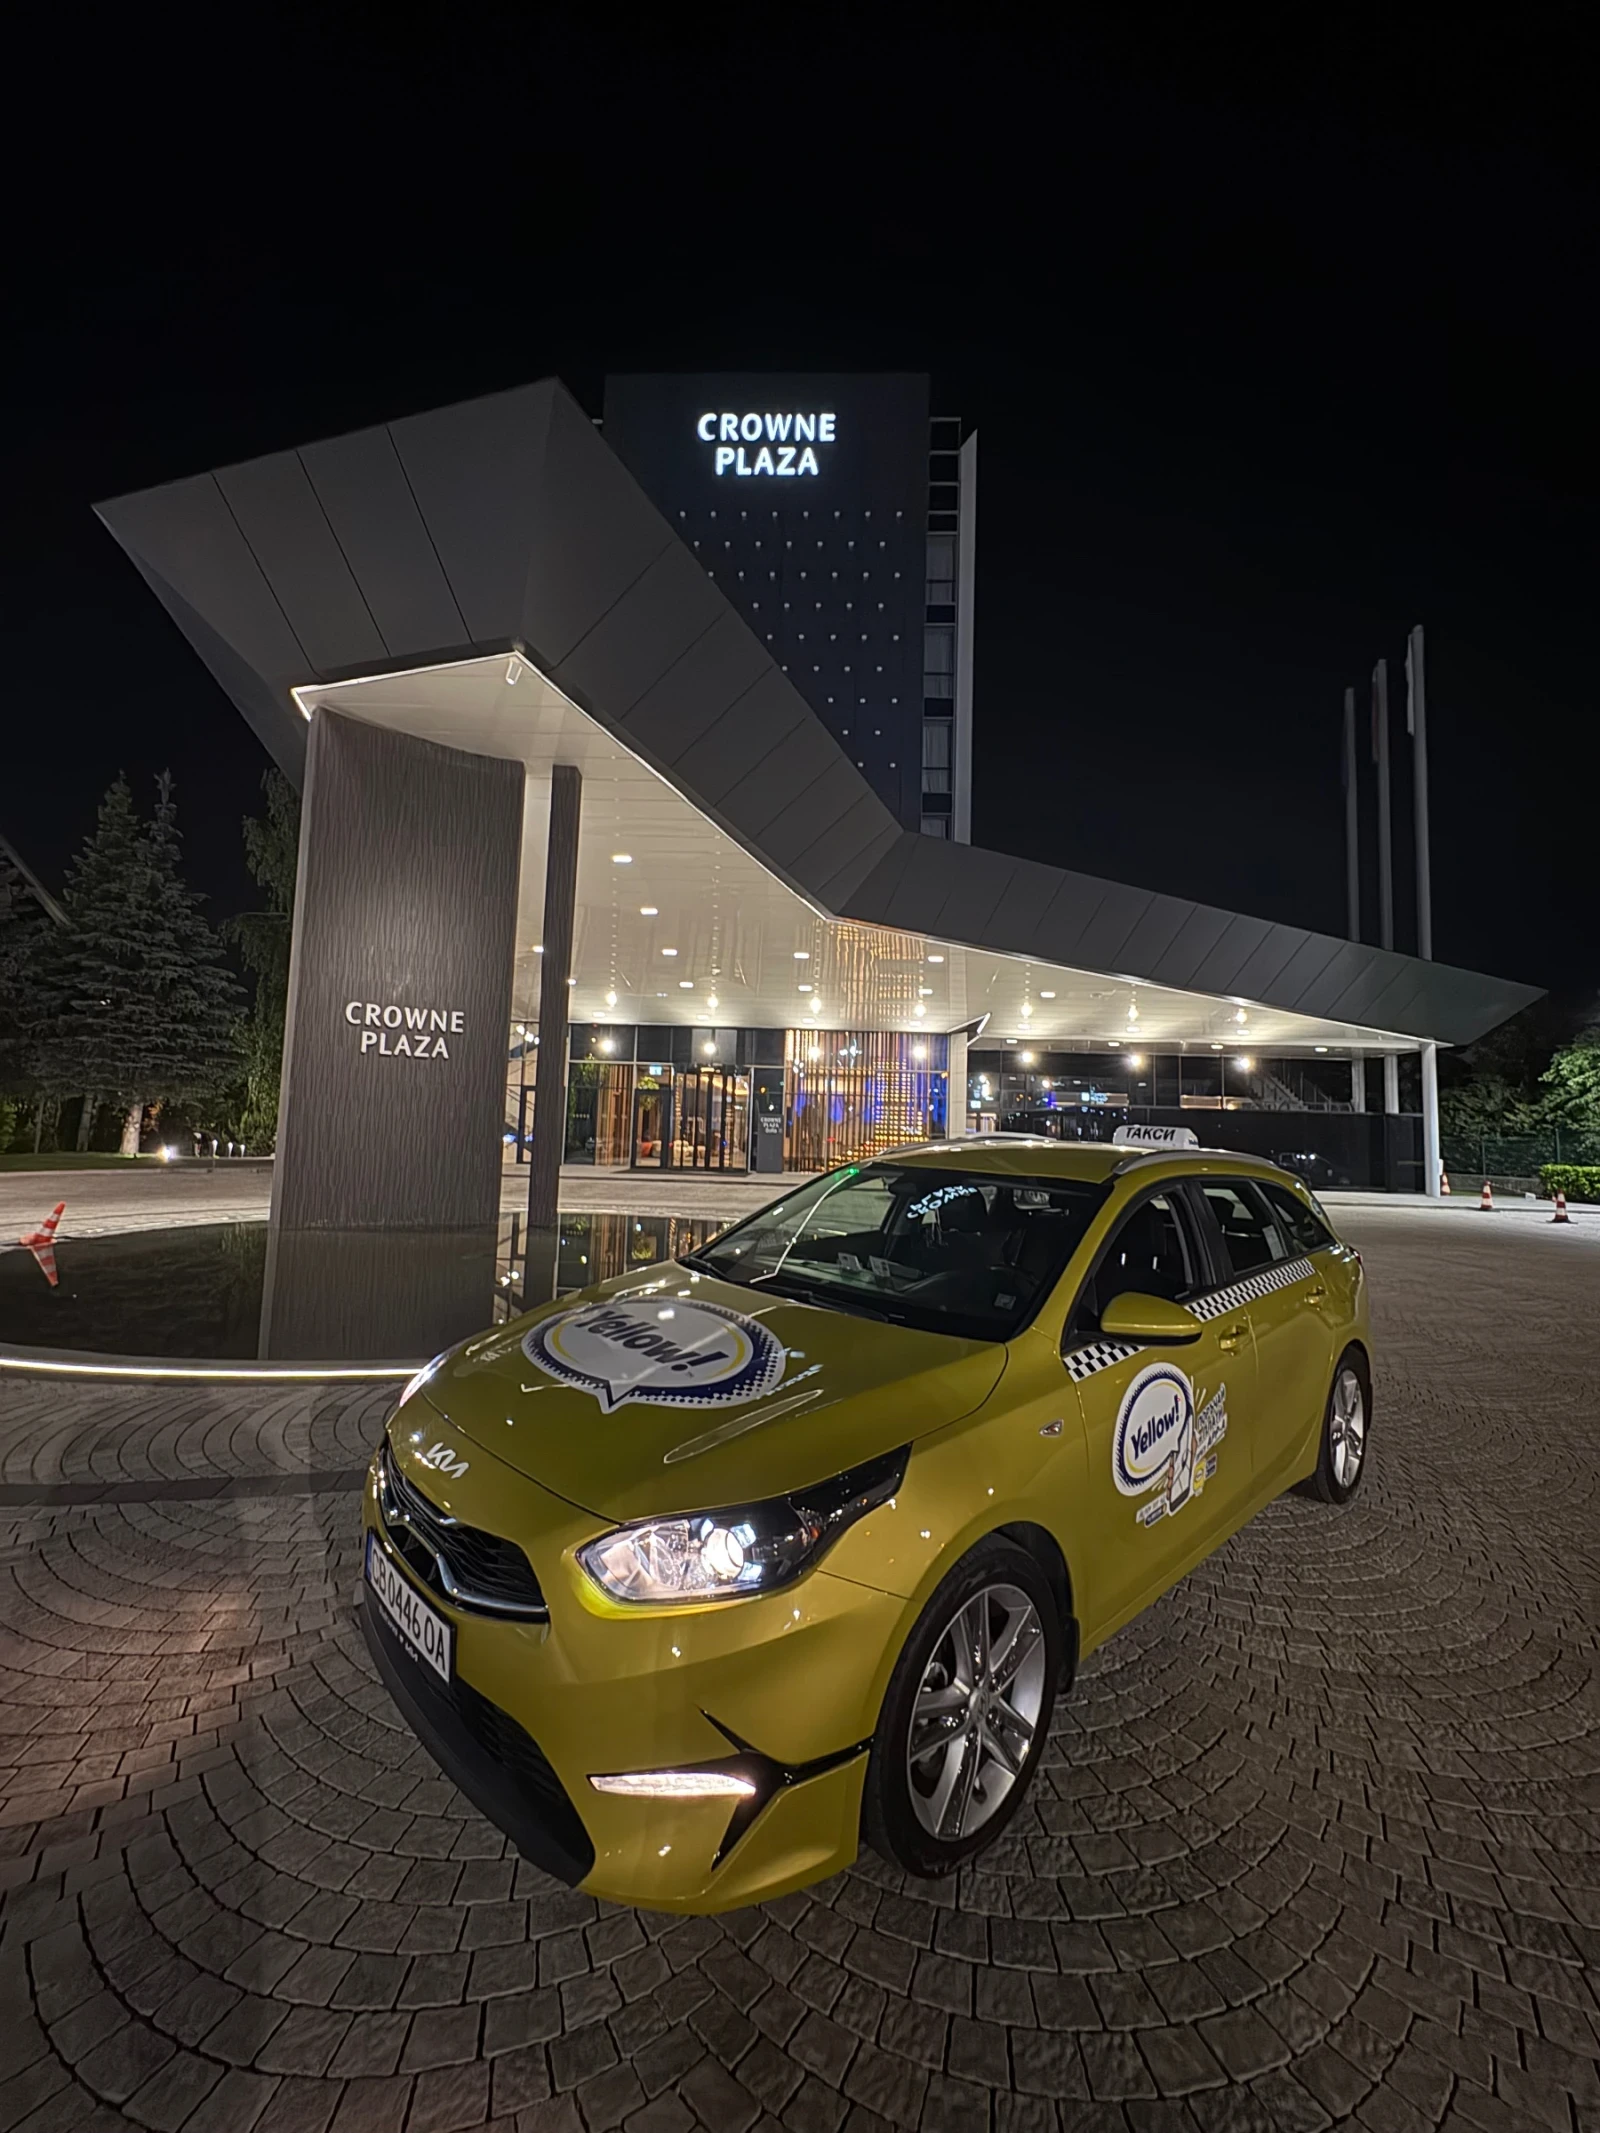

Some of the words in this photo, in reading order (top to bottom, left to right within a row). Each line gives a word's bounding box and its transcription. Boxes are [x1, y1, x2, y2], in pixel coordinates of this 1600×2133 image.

[697, 412, 837, 442] CROWNE
[714, 446, 819, 476] PLAZA
[345, 1001, 465, 1033] CROWNE
[360, 1031, 450, 1060] PLAZA
[1126, 1127, 1176, 1141] ТАКСИ
[574, 1310, 729, 1371] Yellow!
[1130, 1394, 1180, 1461] Yellow!
